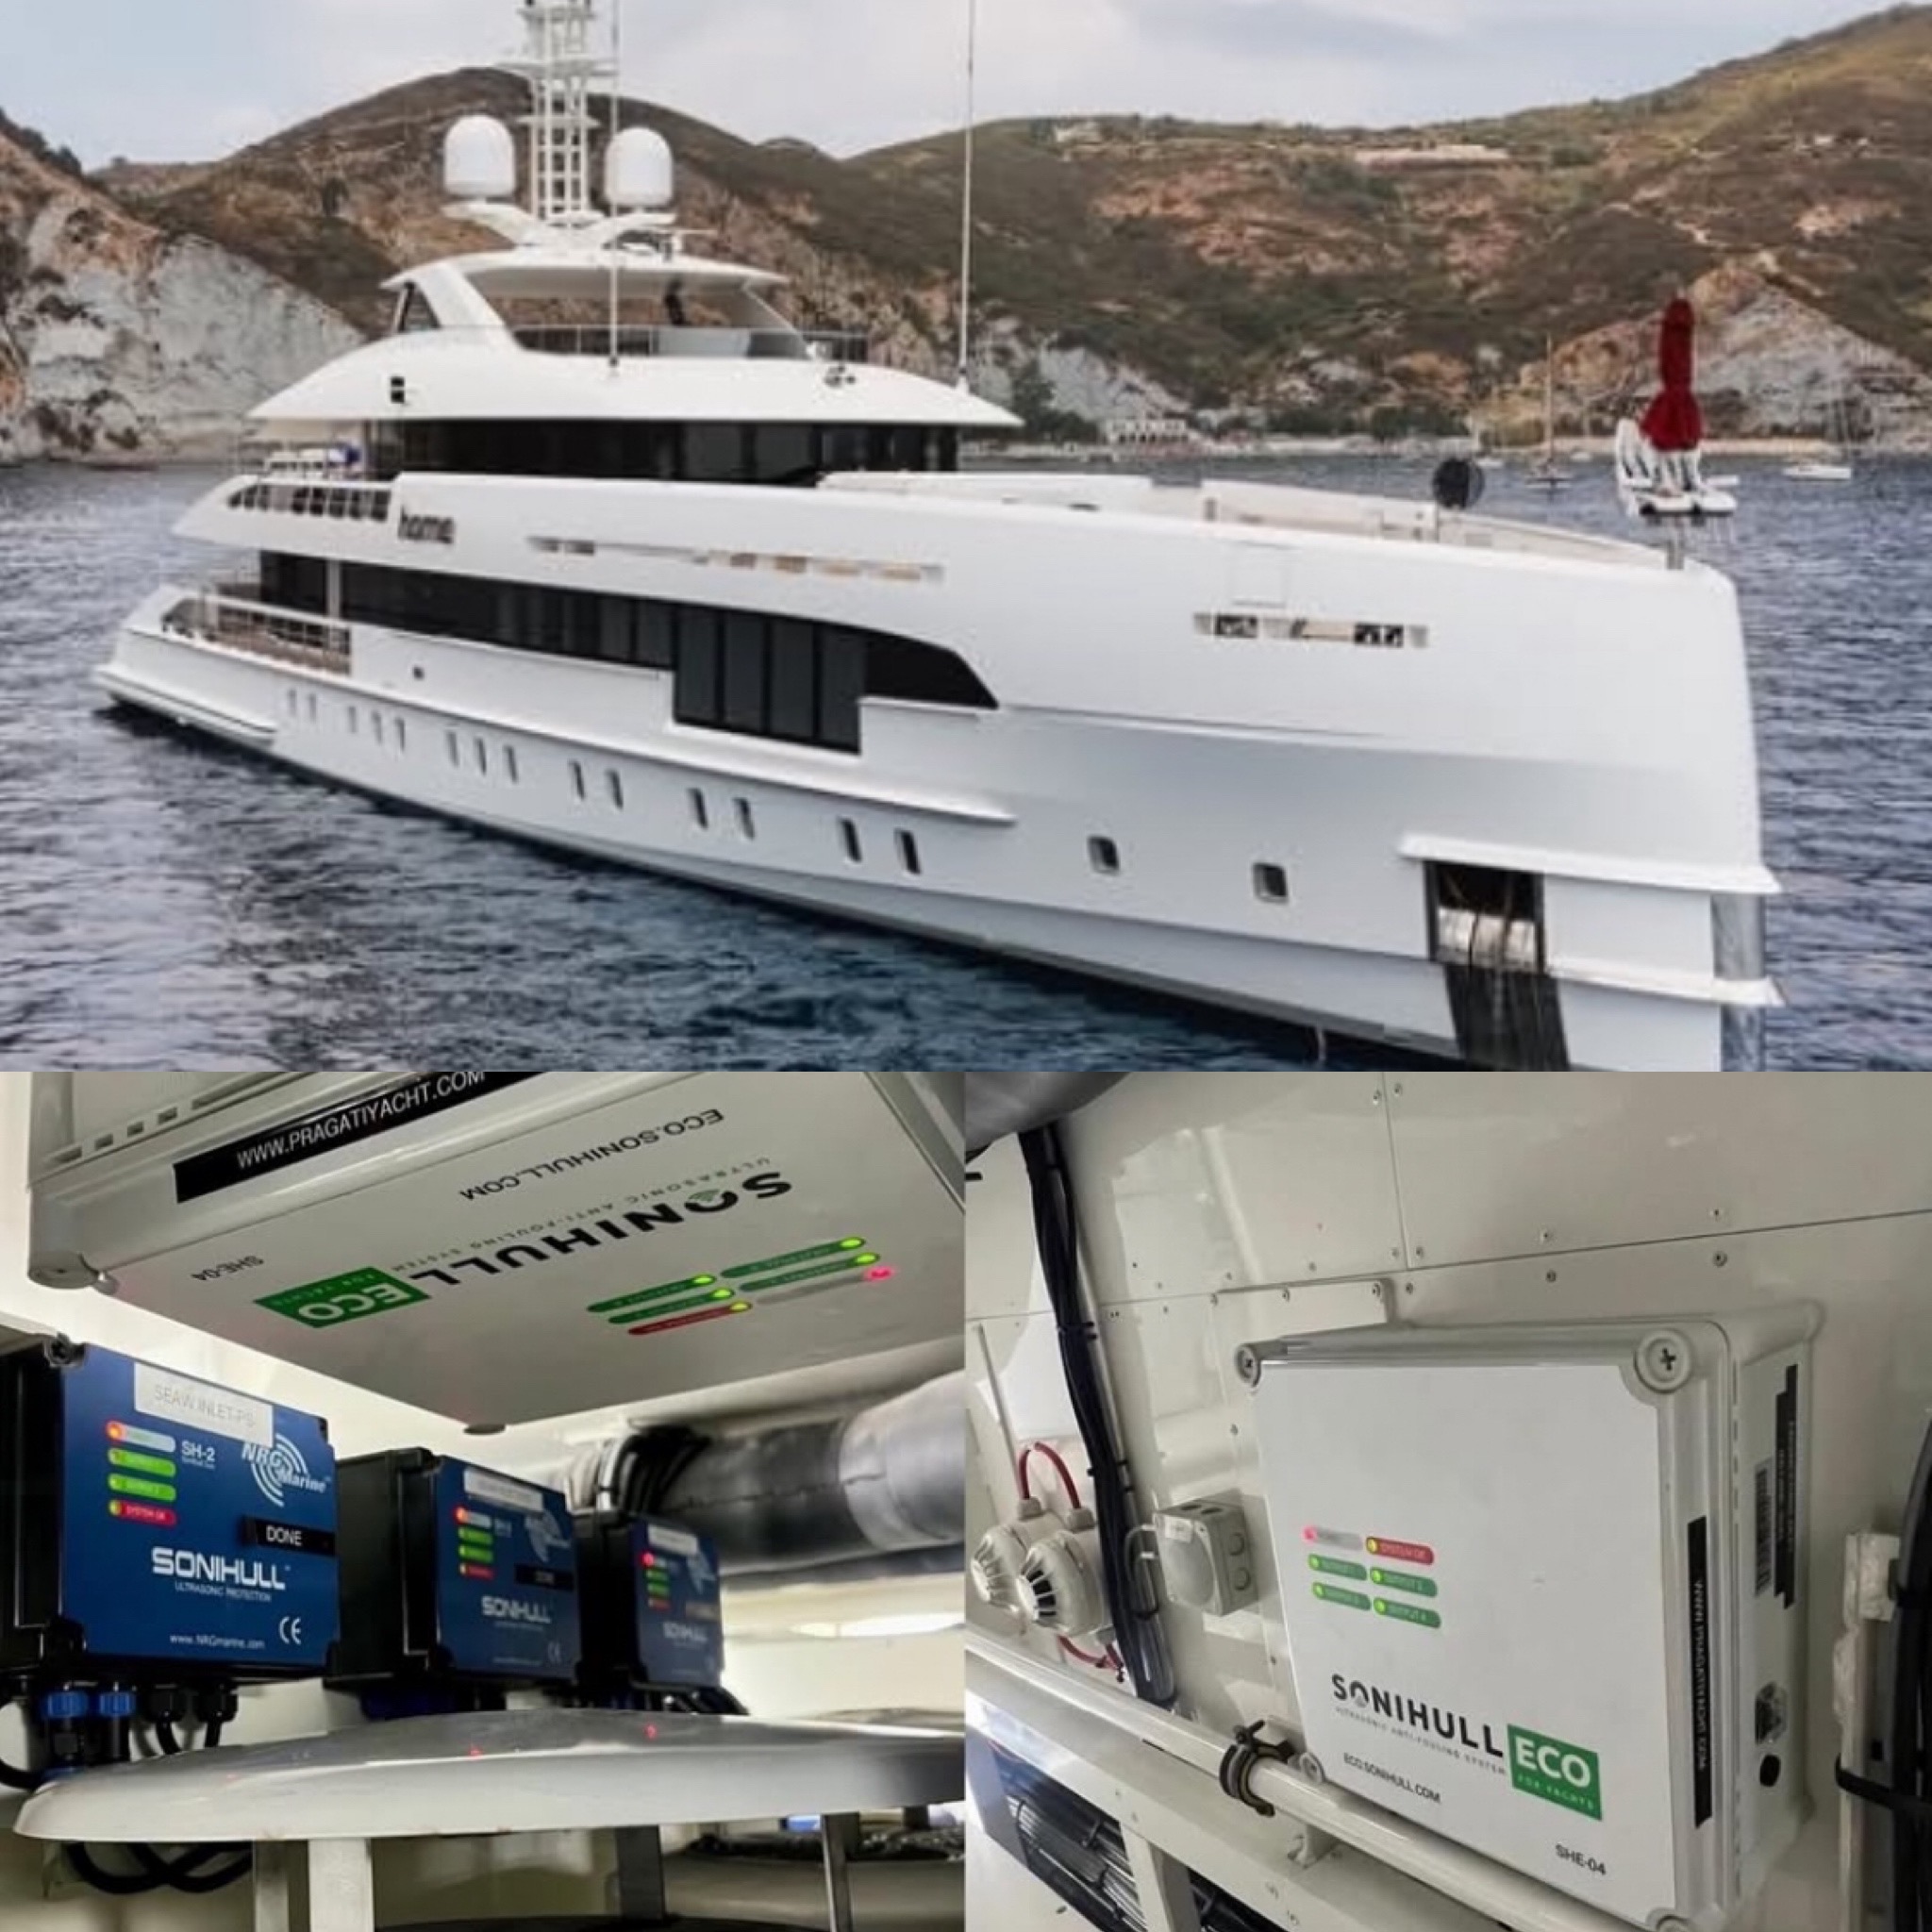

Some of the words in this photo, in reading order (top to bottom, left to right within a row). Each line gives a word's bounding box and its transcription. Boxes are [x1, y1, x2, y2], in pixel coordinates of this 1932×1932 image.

[397, 508, 454, 544] home
[238, 1072, 488, 1169] WWW.PRAGATIYACHT.COM
[458, 1108, 724, 1201] ECO.SONIHULL.COM
[408, 1172, 792, 1285] SONIHULL
[191, 1256, 264, 1281] SHE-04
[298, 1282, 412, 1321] ECO
[181, 1441, 215, 1462] SH-2
[266, 1524, 303, 1546] DONE
[151, 1546, 286, 1591] SONIHULL
[1331, 1674, 1504, 1757] SONIHULL
[1514, 1736, 1591, 1788] ECO
[1556, 1843, 1607, 1875] SHE-04
